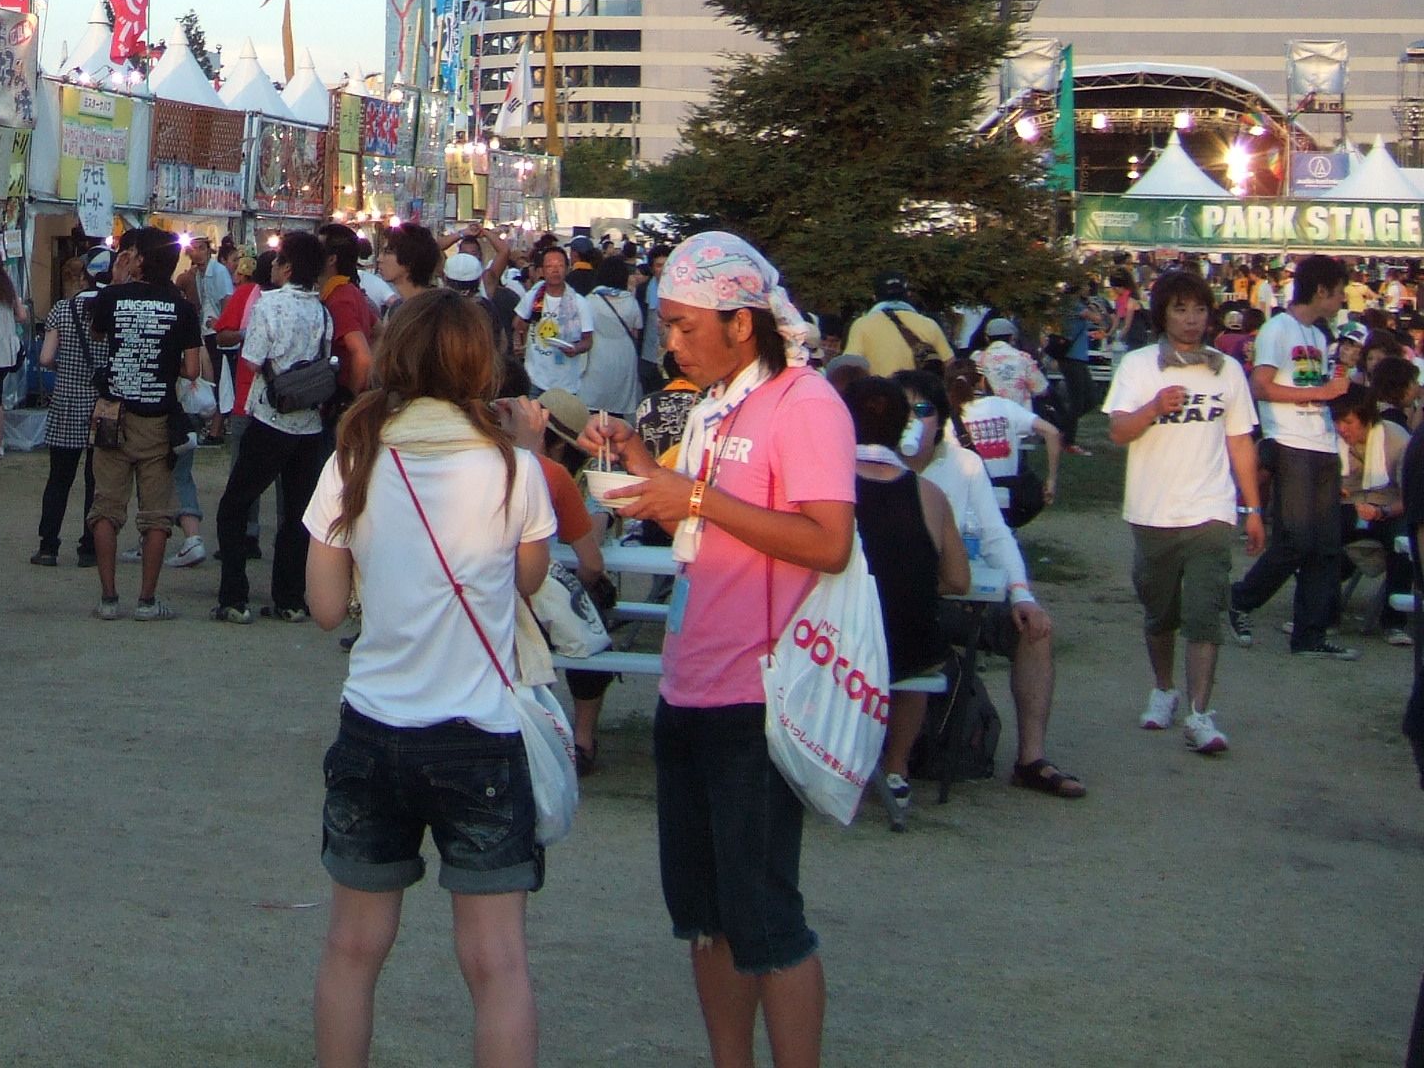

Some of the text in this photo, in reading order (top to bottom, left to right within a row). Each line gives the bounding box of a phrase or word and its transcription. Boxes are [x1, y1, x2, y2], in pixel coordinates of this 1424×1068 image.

[79, 187, 104, 212] バーガー
[1202, 205, 1421, 245] PARK STAGE
